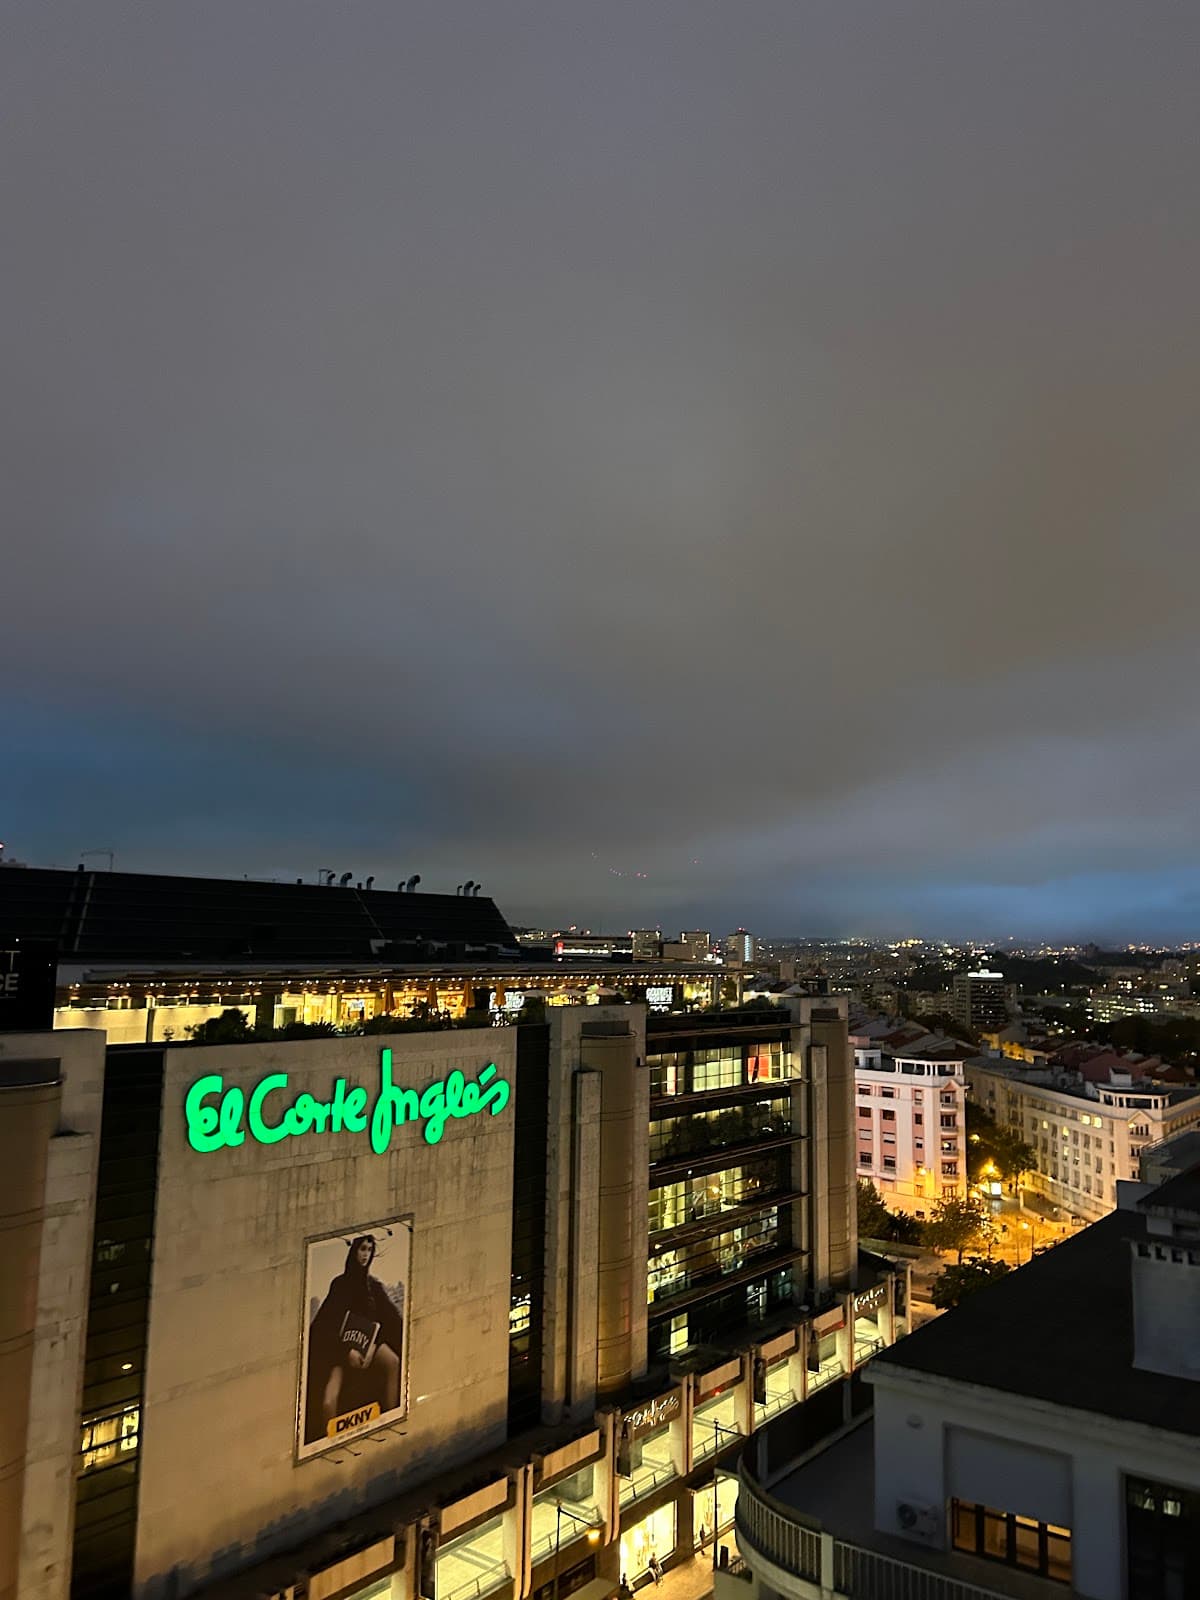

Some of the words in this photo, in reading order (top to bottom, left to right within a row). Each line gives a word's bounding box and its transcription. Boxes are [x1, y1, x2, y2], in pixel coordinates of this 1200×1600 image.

[185, 1074, 245, 1153] El
[249, 1073, 368, 1144] Corte
[370, 1048, 511, 1155] Inglés
[343, 1330, 370, 1349] DKNY
[335, 1407, 374, 1433] DKNY
